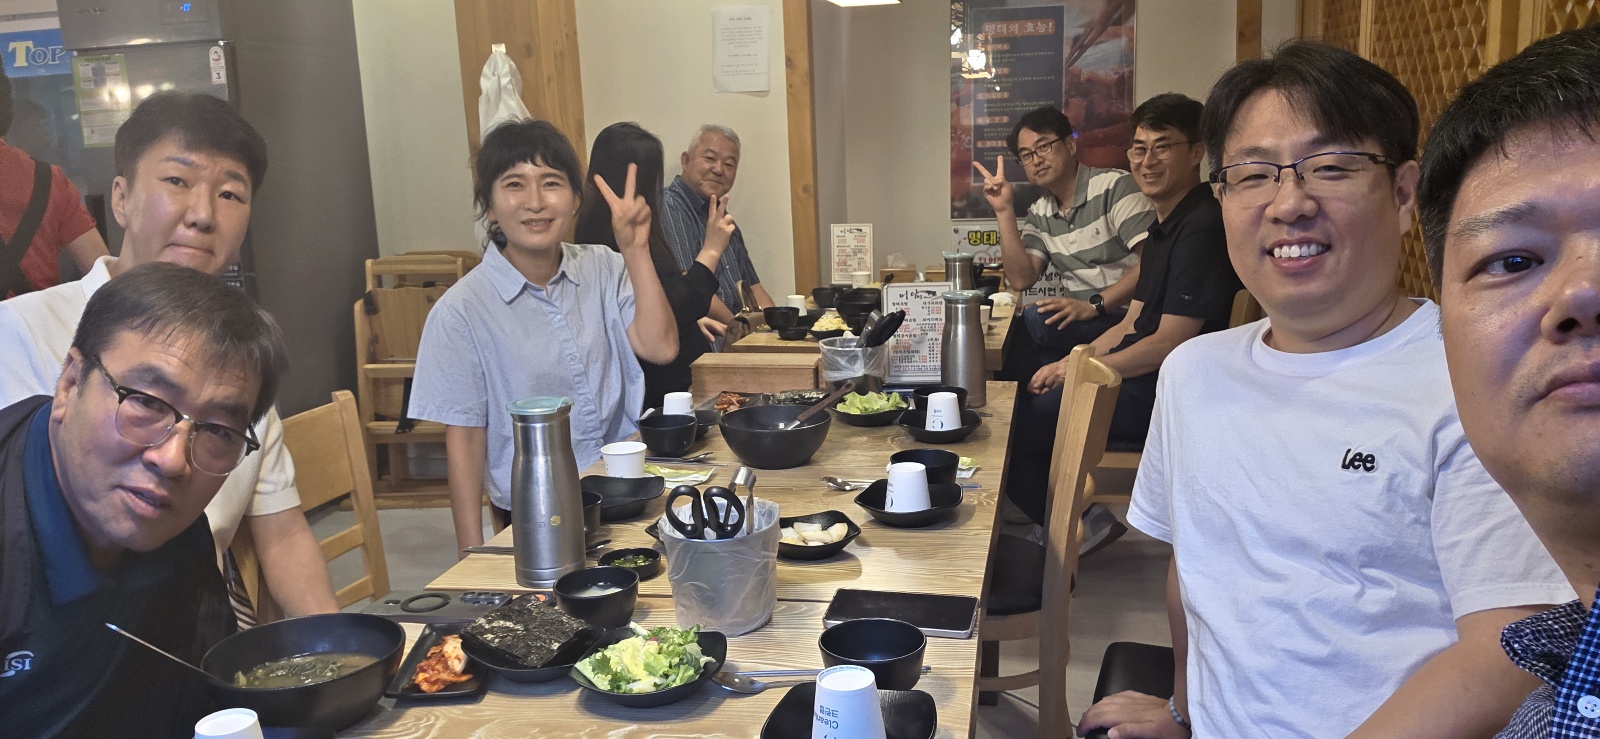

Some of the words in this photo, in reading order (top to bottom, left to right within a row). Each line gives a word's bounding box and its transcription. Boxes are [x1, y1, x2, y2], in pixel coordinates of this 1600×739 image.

[985, 22, 1019, 35] 명태의
[1024, 21, 1053, 33] 효능!
[968, 231, 1000, 245] 명태
[1341, 448, 1376, 472] Lee
